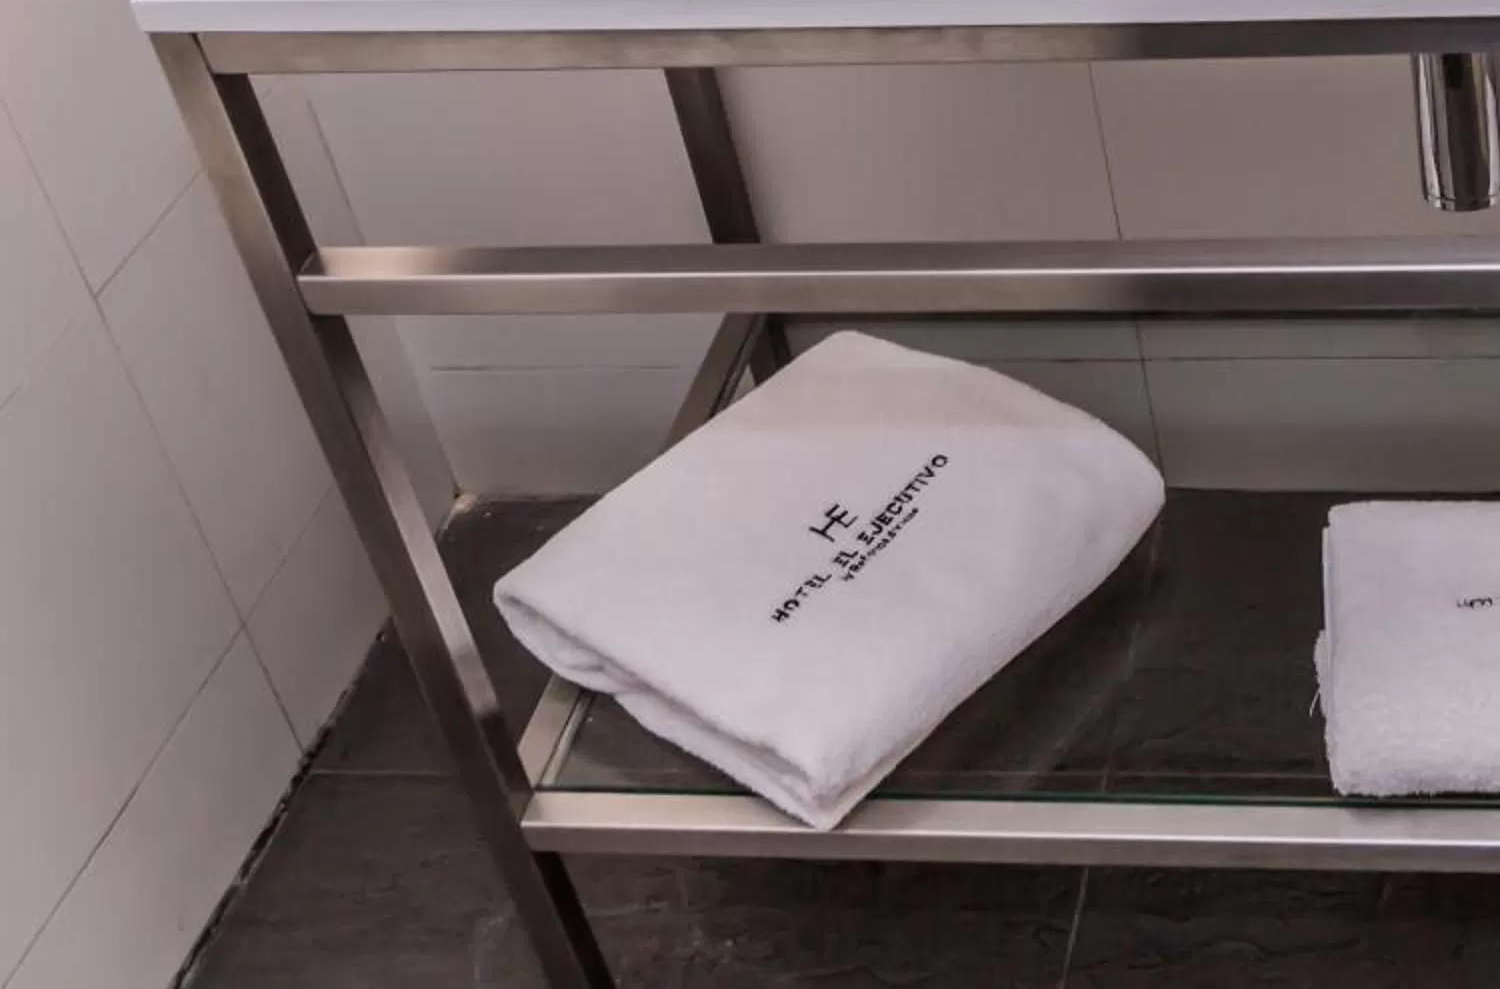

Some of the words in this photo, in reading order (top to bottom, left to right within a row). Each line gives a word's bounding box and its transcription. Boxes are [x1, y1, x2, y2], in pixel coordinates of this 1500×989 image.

[772, 574, 833, 623] HOTEL
[832, 550, 859, 568] EL
[857, 454, 949, 546] EJECUTIVO
